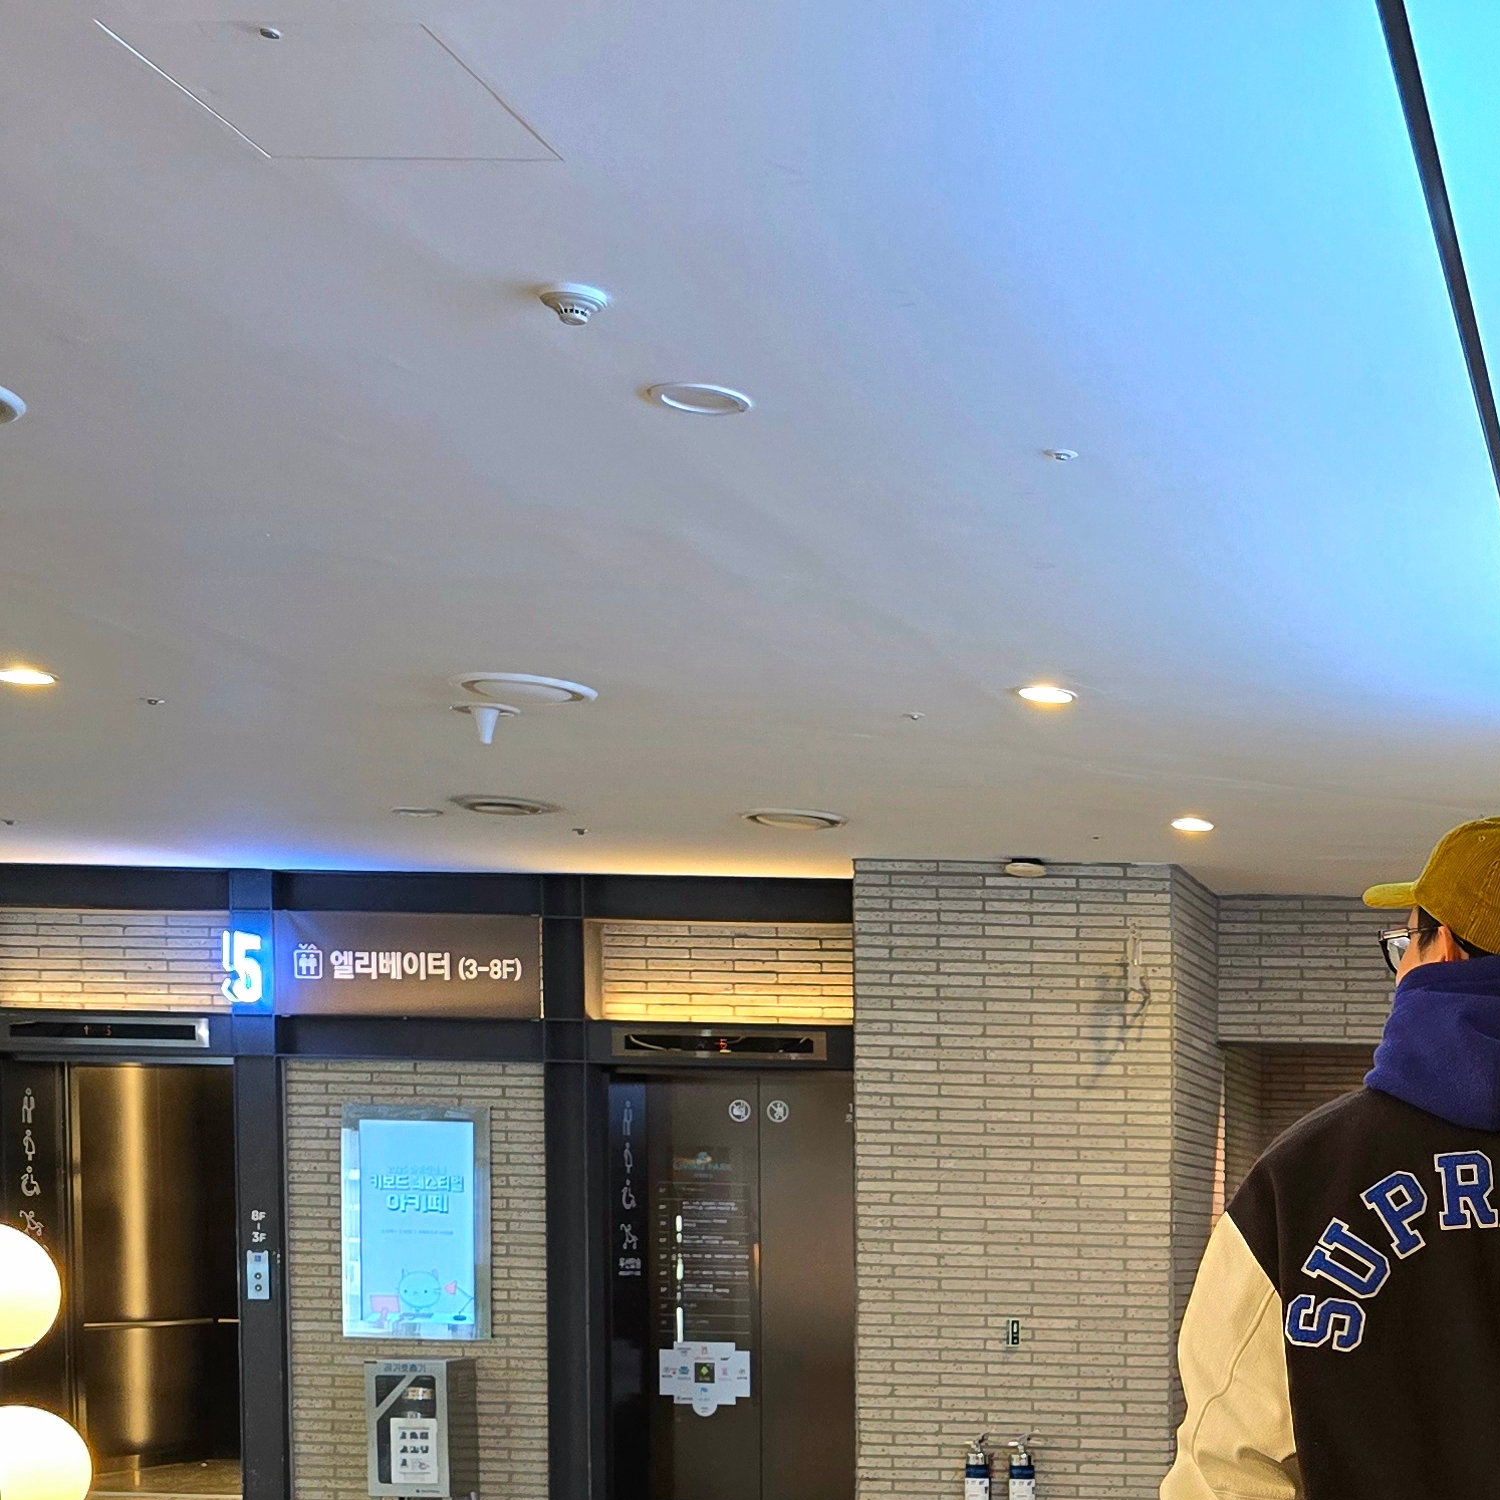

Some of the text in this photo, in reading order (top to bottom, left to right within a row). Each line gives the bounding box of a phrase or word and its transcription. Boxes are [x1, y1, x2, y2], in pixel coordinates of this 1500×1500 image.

[222, 929, 263, 1003] 5
[329, 949, 523, 982] 엘리베이터 (3-8F)
[251, 1209, 267, 1221] 8F
[251, 1231, 267, 1243] 3F
